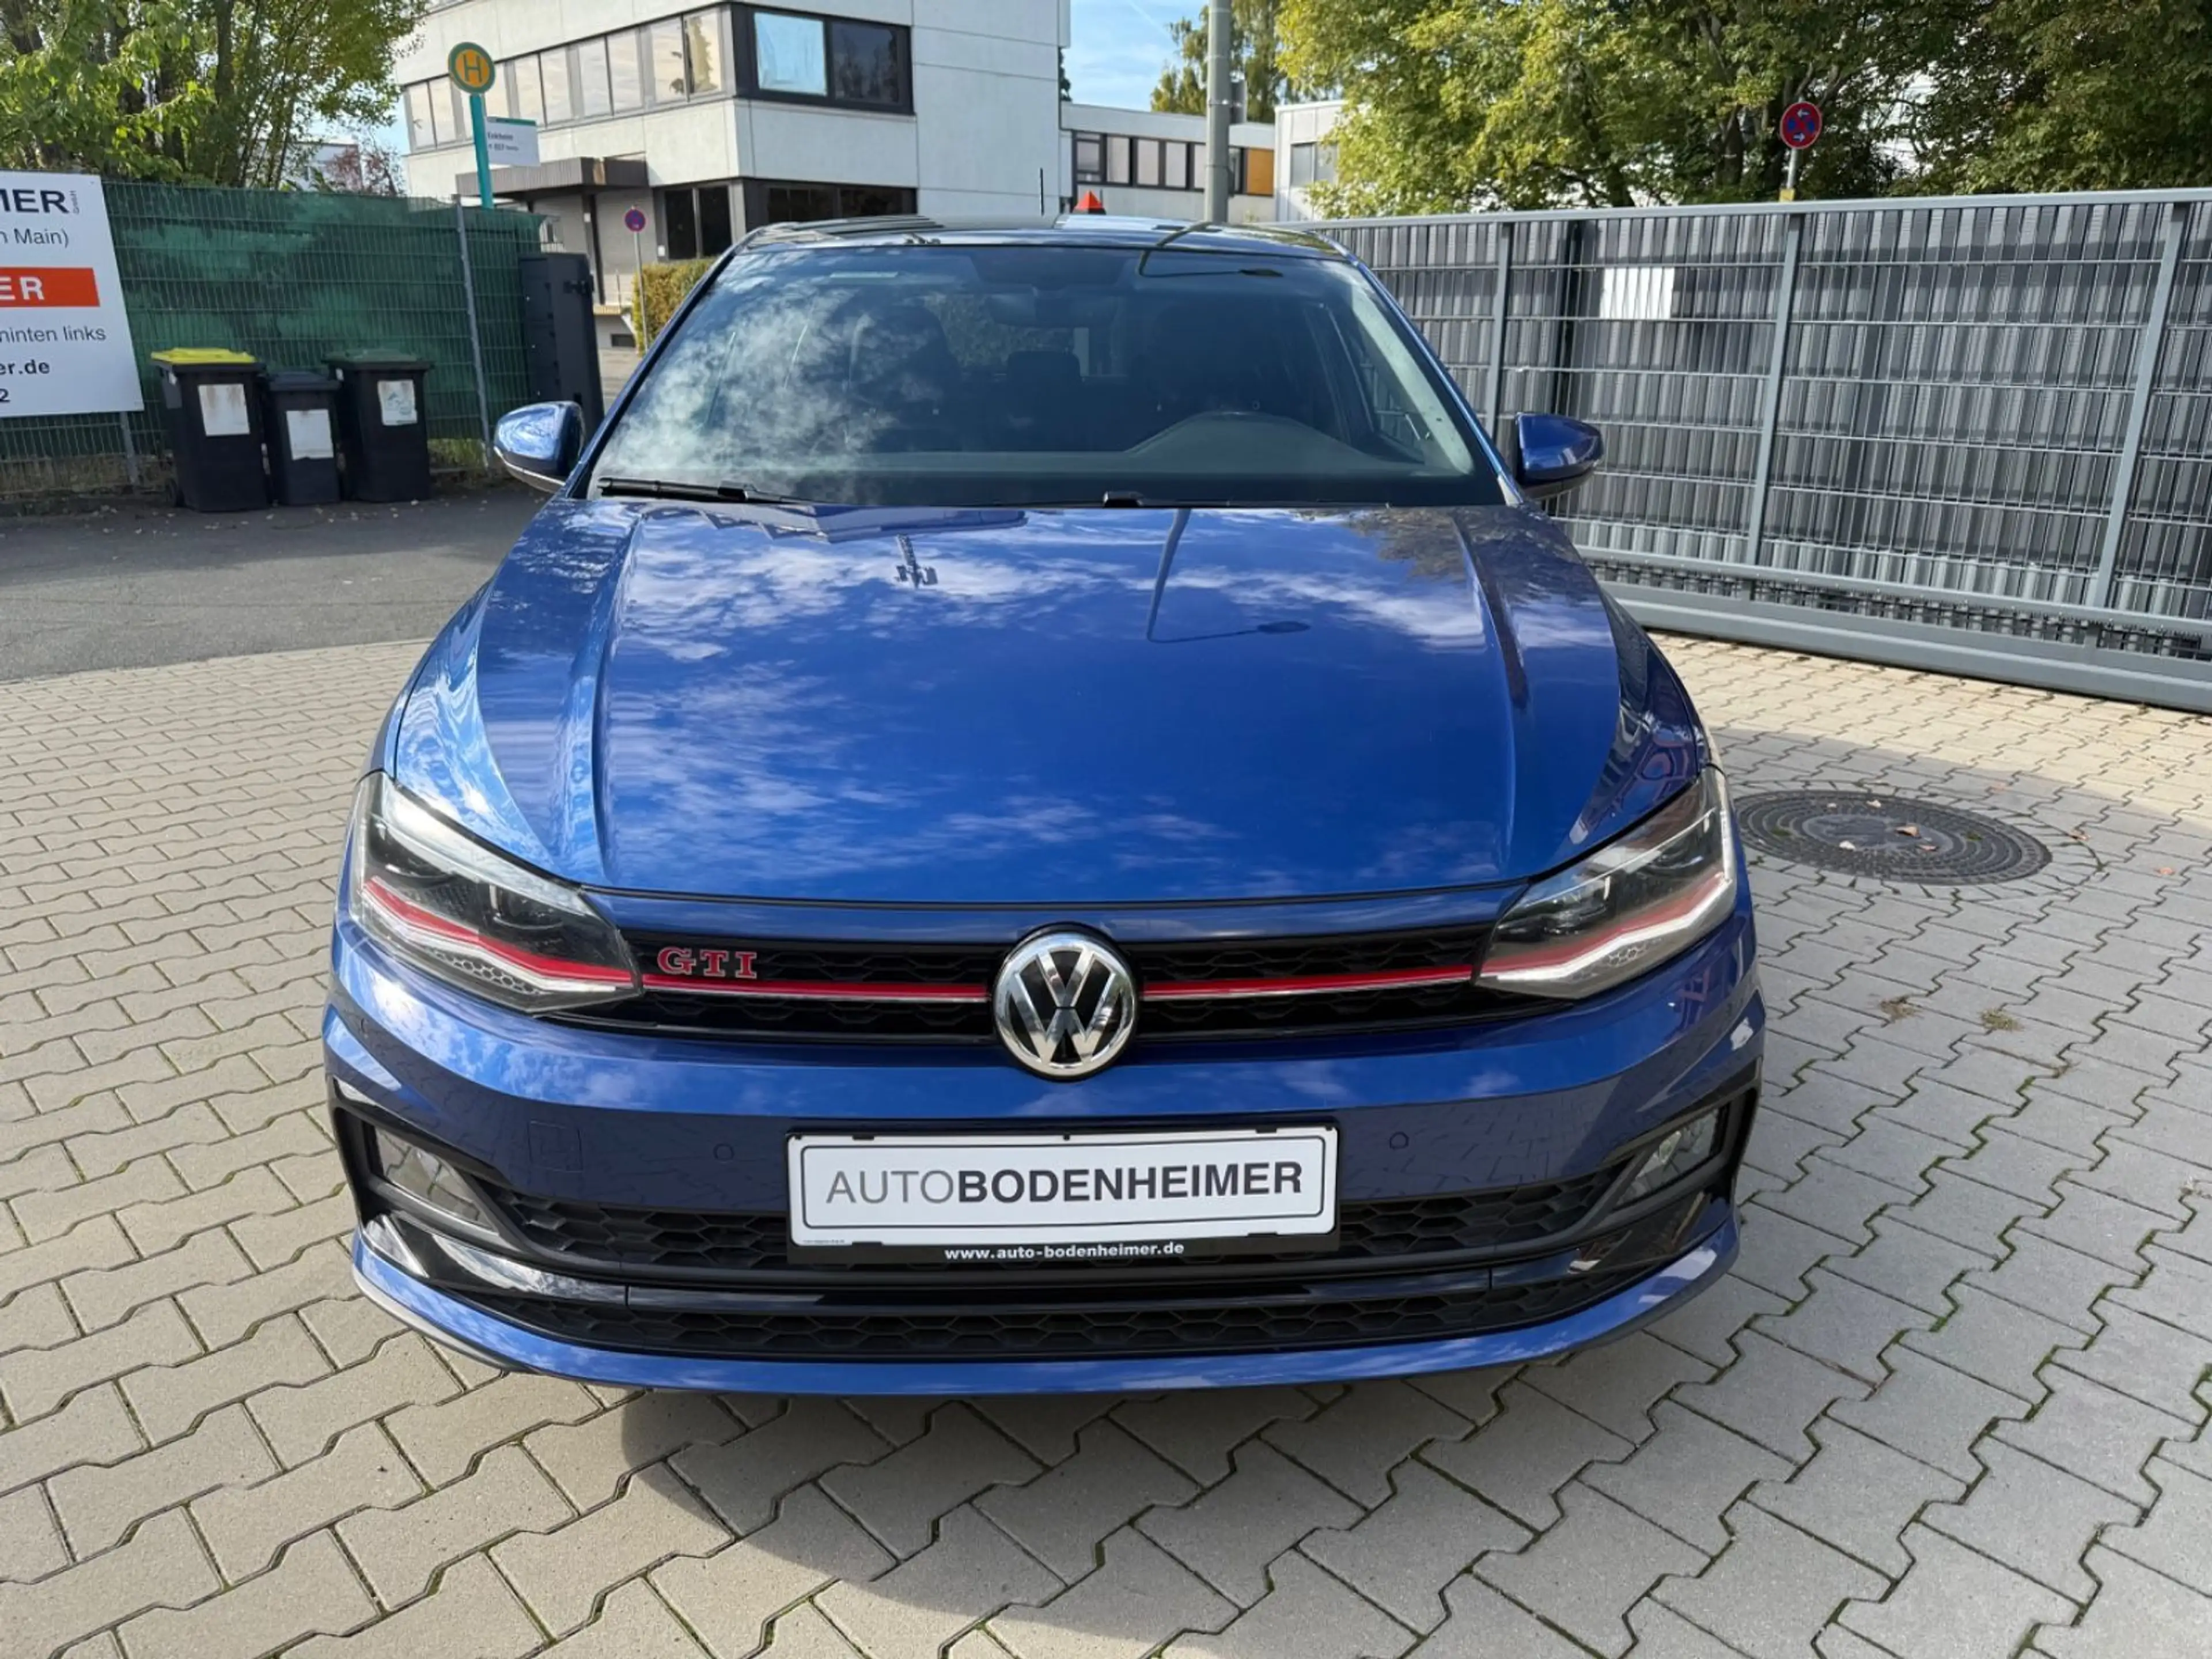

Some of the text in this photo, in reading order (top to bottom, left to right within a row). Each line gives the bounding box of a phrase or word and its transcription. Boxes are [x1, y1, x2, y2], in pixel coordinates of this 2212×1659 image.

[463, 52, 483, 83] H
[14, 228, 69, 249] Main)
[63, 325, 107, 341] links
[657, 946, 757, 979] GTI
[825, 1161, 1304, 1205] AUTOBODENHEIMER
[944, 1241, 1185, 1260] www.auto-bodenheimer.de
